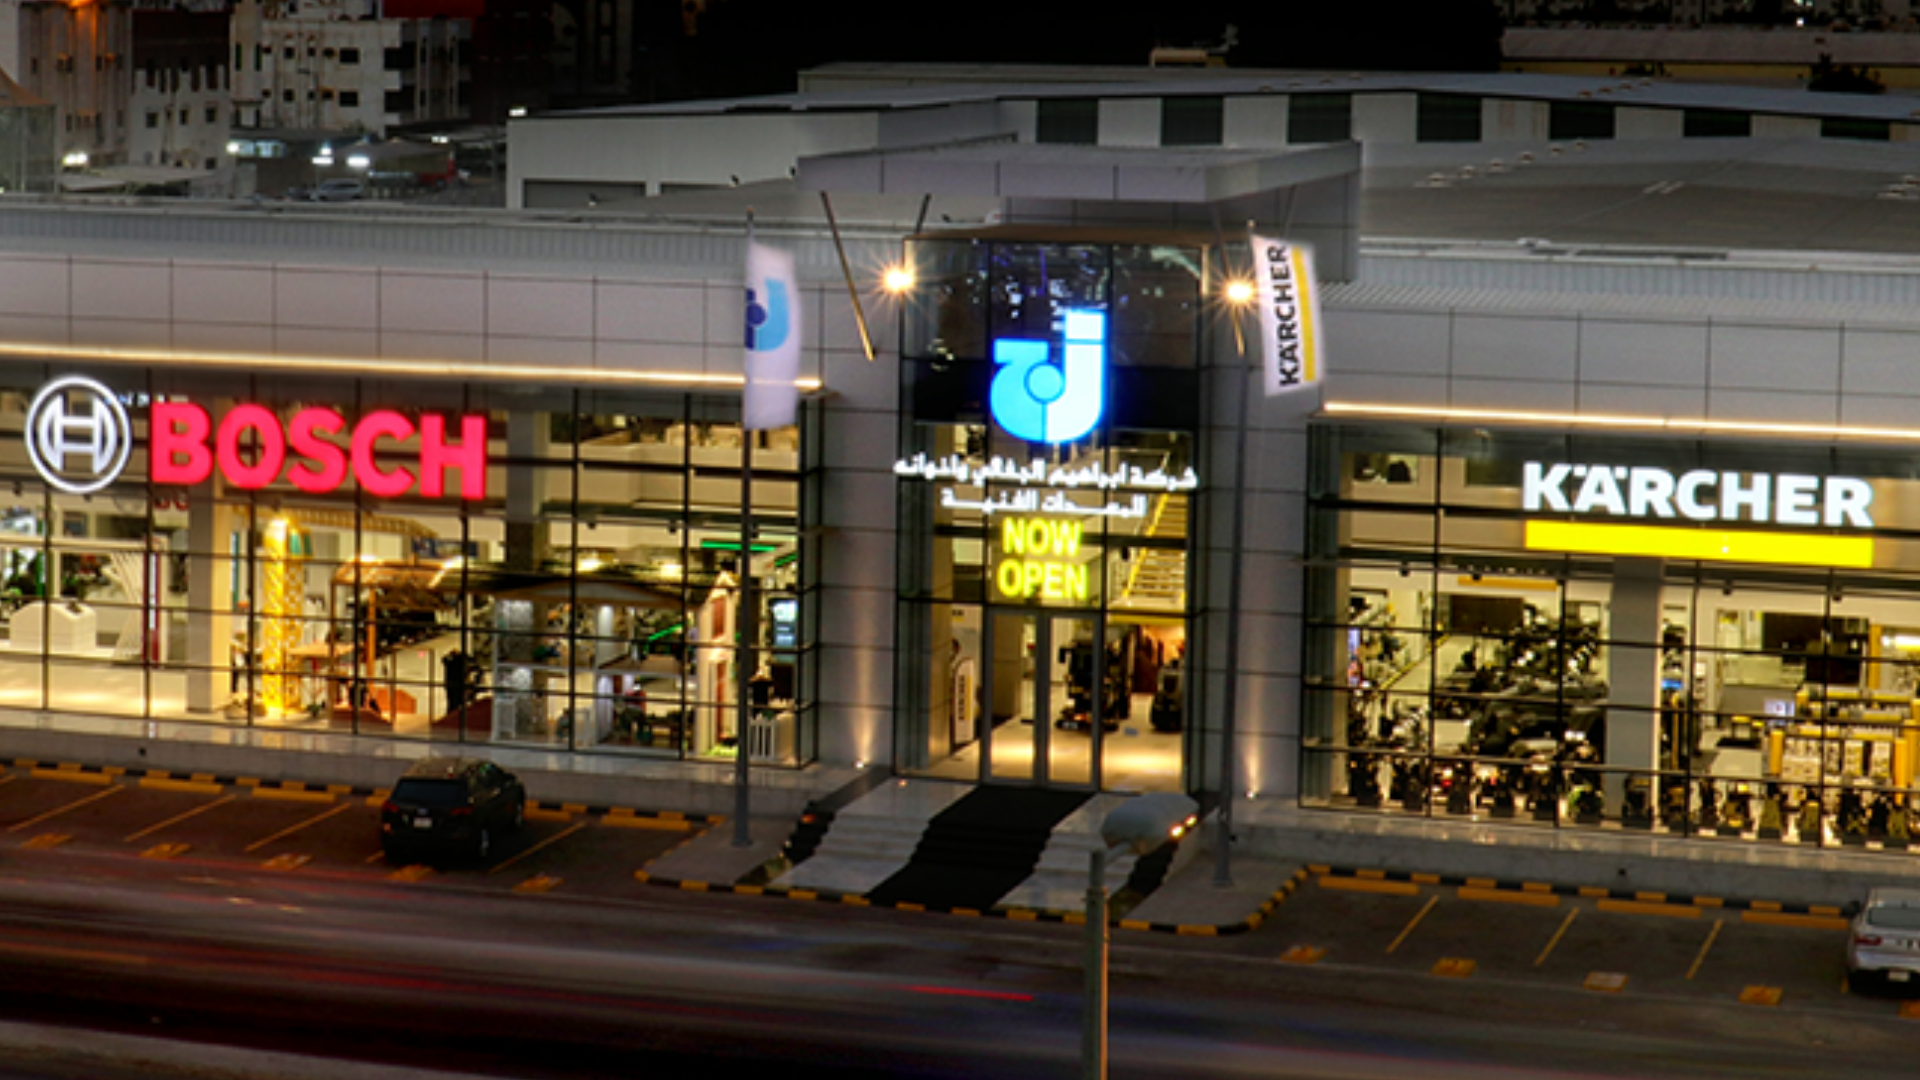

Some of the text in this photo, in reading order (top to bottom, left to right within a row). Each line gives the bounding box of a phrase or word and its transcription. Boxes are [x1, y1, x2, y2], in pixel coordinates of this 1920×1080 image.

[1267, 246, 1300, 387] KÄRCHER
[150, 401, 487, 500] BOSCH
[1522, 461, 1875, 528] KÄRCHER
[1002, 516, 1084, 557] NOW
[996, 558, 1088, 600] OPEN
